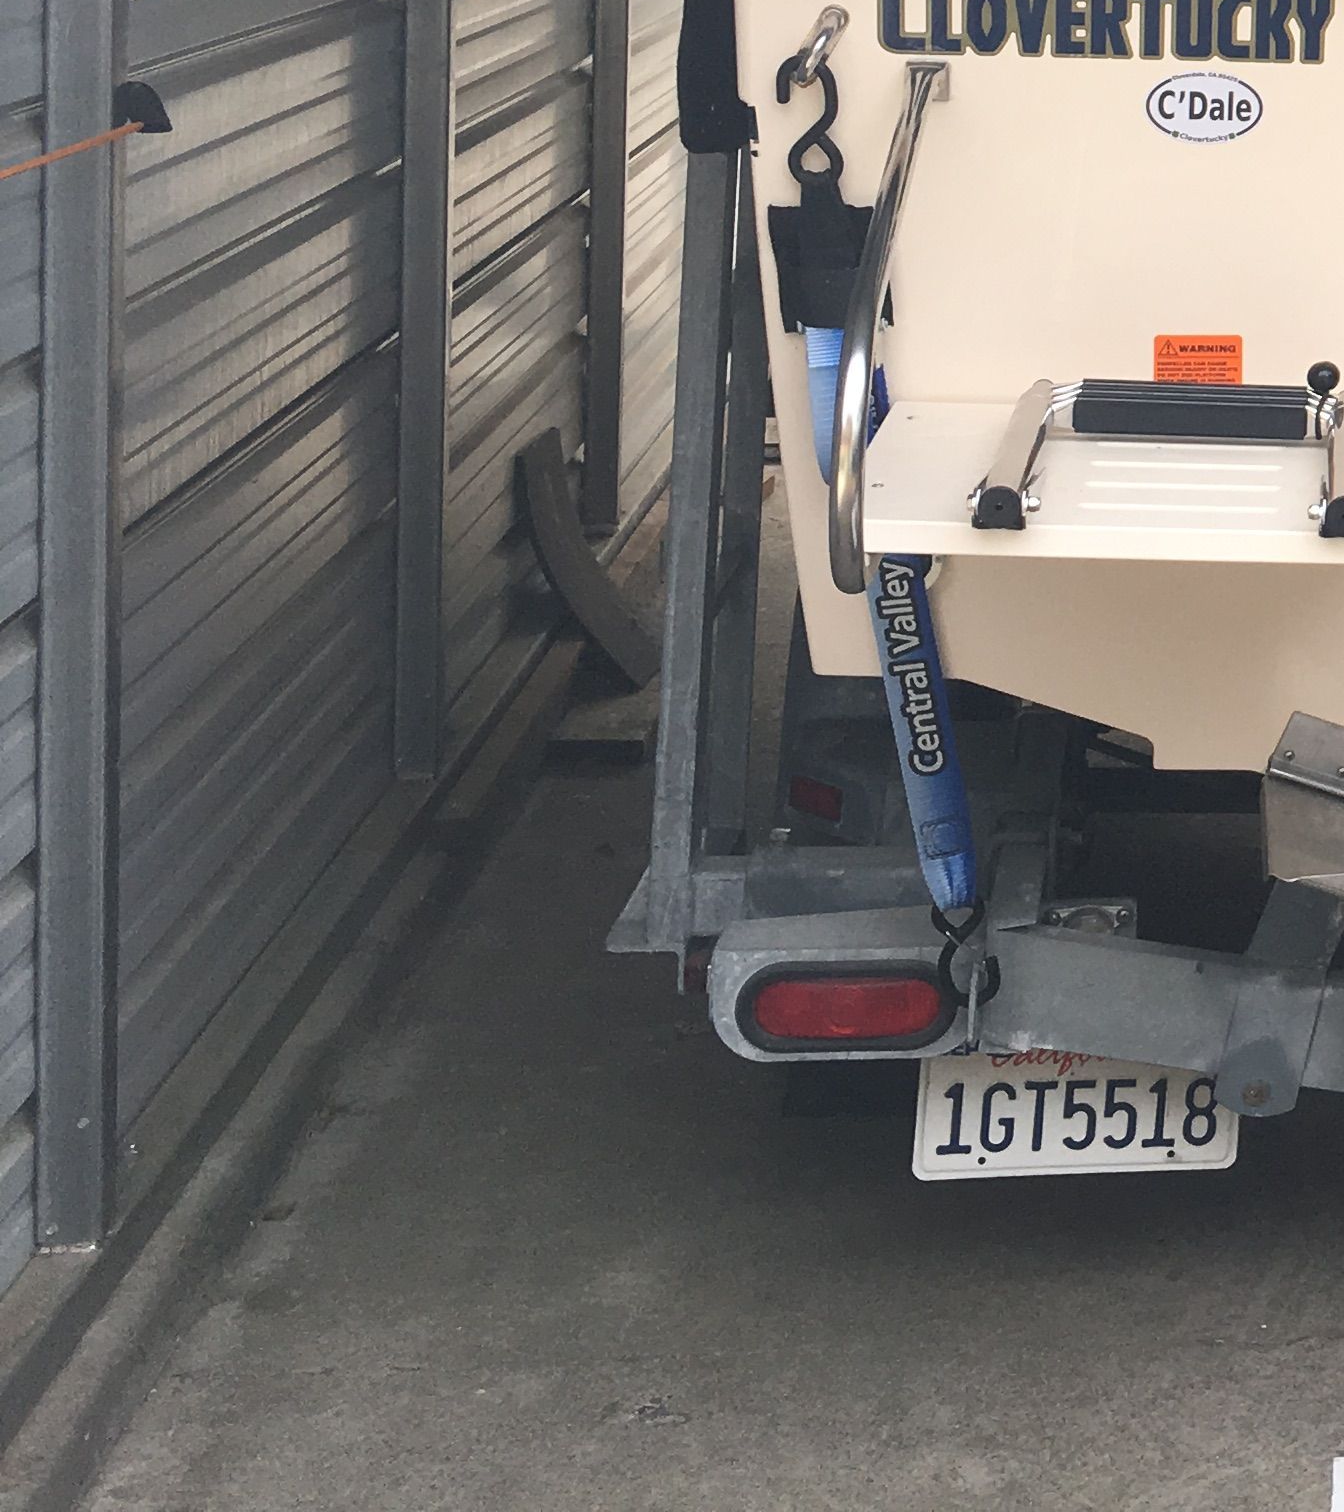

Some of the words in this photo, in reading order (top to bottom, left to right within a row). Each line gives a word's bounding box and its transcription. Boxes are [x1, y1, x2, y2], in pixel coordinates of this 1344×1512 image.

[1178, 344, 1237, 353] WARNING
[880, 562, 920, 655] Valley
[893, 662, 944, 773] Central
[935, 1076, 1218, 1156] 1GT5518
